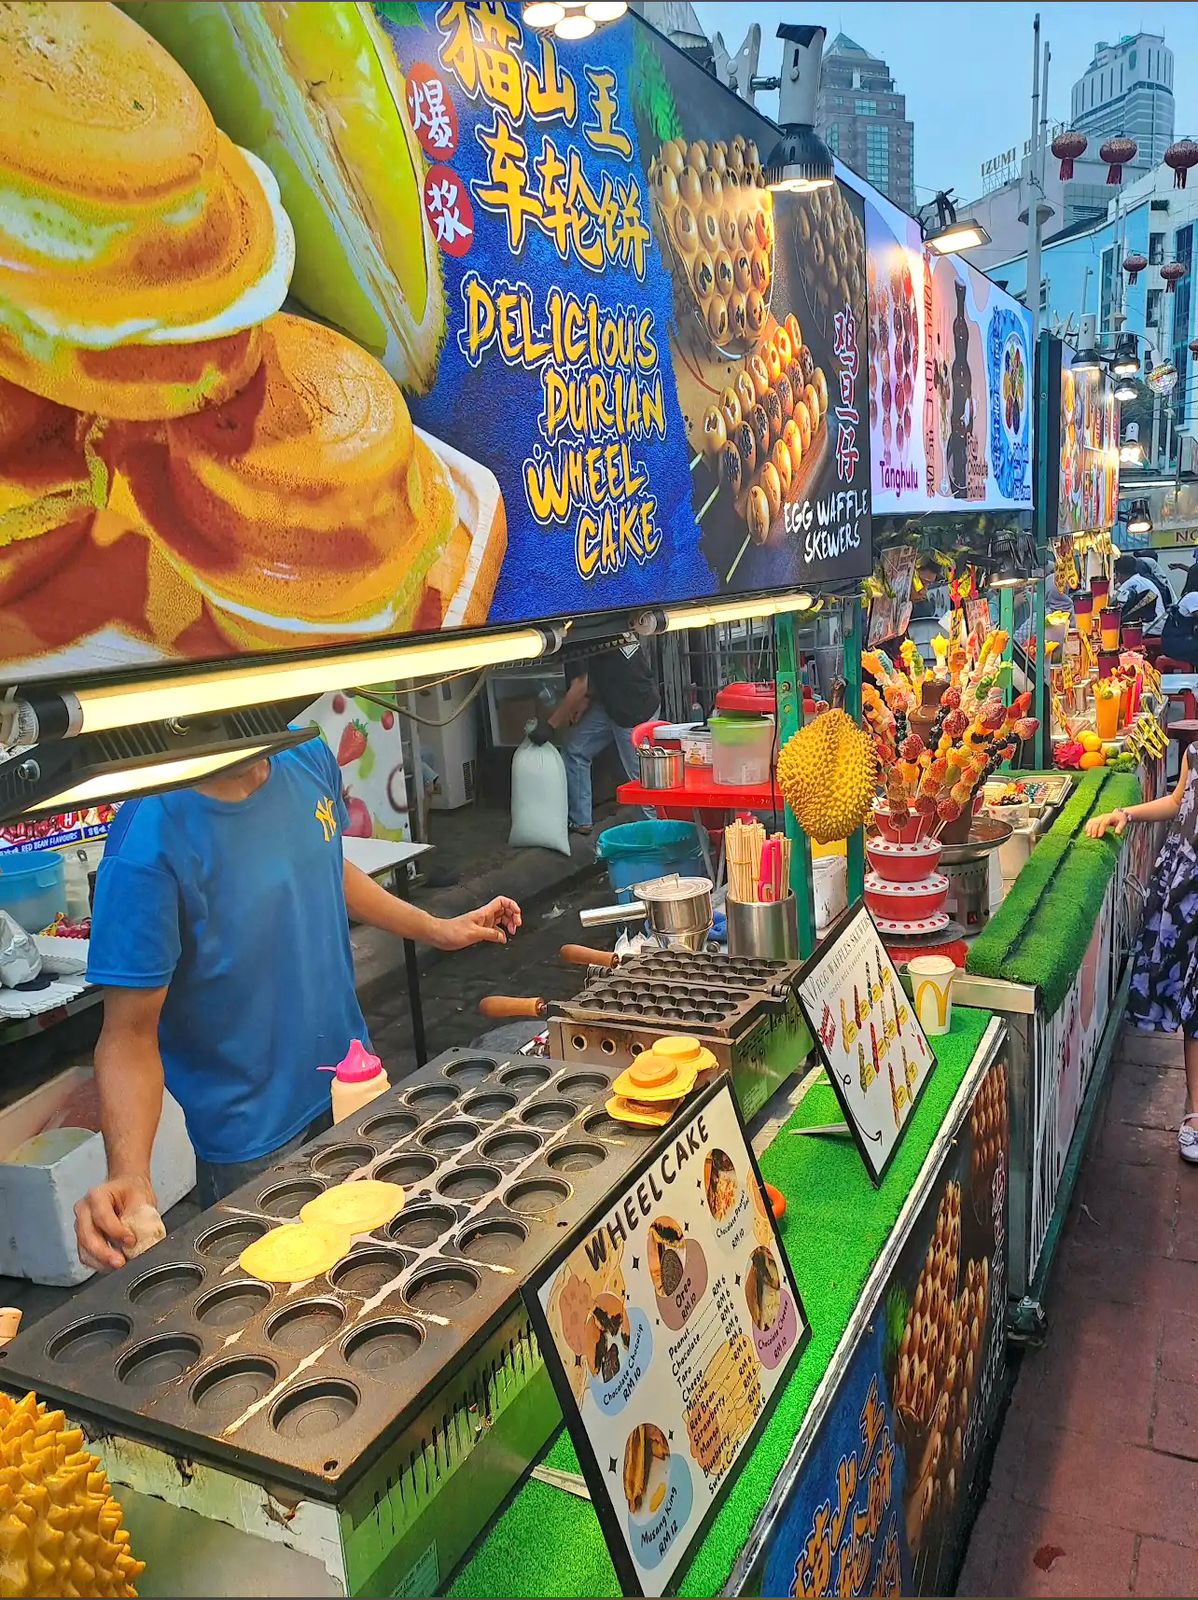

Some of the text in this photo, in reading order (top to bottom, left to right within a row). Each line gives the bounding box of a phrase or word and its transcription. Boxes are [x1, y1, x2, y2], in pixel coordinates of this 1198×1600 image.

[437, 2, 632, 161] 猫山王
[406, 79, 473, 244] 爆浆
[471, 108, 650, 282] 车轮饼
[981, 147, 1016, 177] IZUMI
[459, 272, 658, 372] DELICIOUS
[542, 367, 666, 439] DURIAN
[524, 439, 648, 522] WHEEL
[783, 489, 868, 533] EGG WAFFLE
[879, 460, 919, 498] Tanghulu
[575, 496, 662, 579] CAKE
[804, 520, 860, 563] SKEWERS
[21, 844, 33, 852] RED
[33, 839, 49, 850] BEAN
[49, 831, 78, 846] FLAVOURS
[813, 967, 830, 993] EGG
[826, 938, 852, 976] WAFFLES
[668, 1326, 690, 1361] Peanut
[712, 1279, 722, 1298] RM
[675, 1277, 691, 1308] Oreo
[681, 1292, 697, 1321] RM 10
[672, 1333, 700, 1376] Chocolate
[716, 1292, 727, 1311] RM
[676, 1365, 692, 1389] Taro
[720, 1304, 731, 1323] RM
[682, 1369, 704, 1403] Cheese
[725, 1318, 735, 1337] RM
[686, 1379, 709, 1417] Matcha
[729, 1330, 739, 1348] RM
[773, 1342, 783, 1360] RM
[603, 1369, 629, 1405] Chocolate
[622, 1366, 641, 1402] RM 10
[690, 1408, 702, 1433] Red
[700, 1390, 716, 1413] Bean
[733, 1341, 744, 1362] RM
[693, 1395, 726, 1447] Strawberry
[738, 1359, 748, 1376] RM
[700, 1426, 720, 1459] Mango
[743, 1372, 753, 1389] RM
[702, 1433, 731, 1478] Blueberry
[747, 1387, 758, 1405] RM
[708, 1464, 727, 1495] Sweet
[725, 1439, 741, 1465] Corn
[753, 1403, 763, 1420] RM
[641, 1486, 677, 1548] Musang King
[658, 1519, 678, 1556] RM 12
